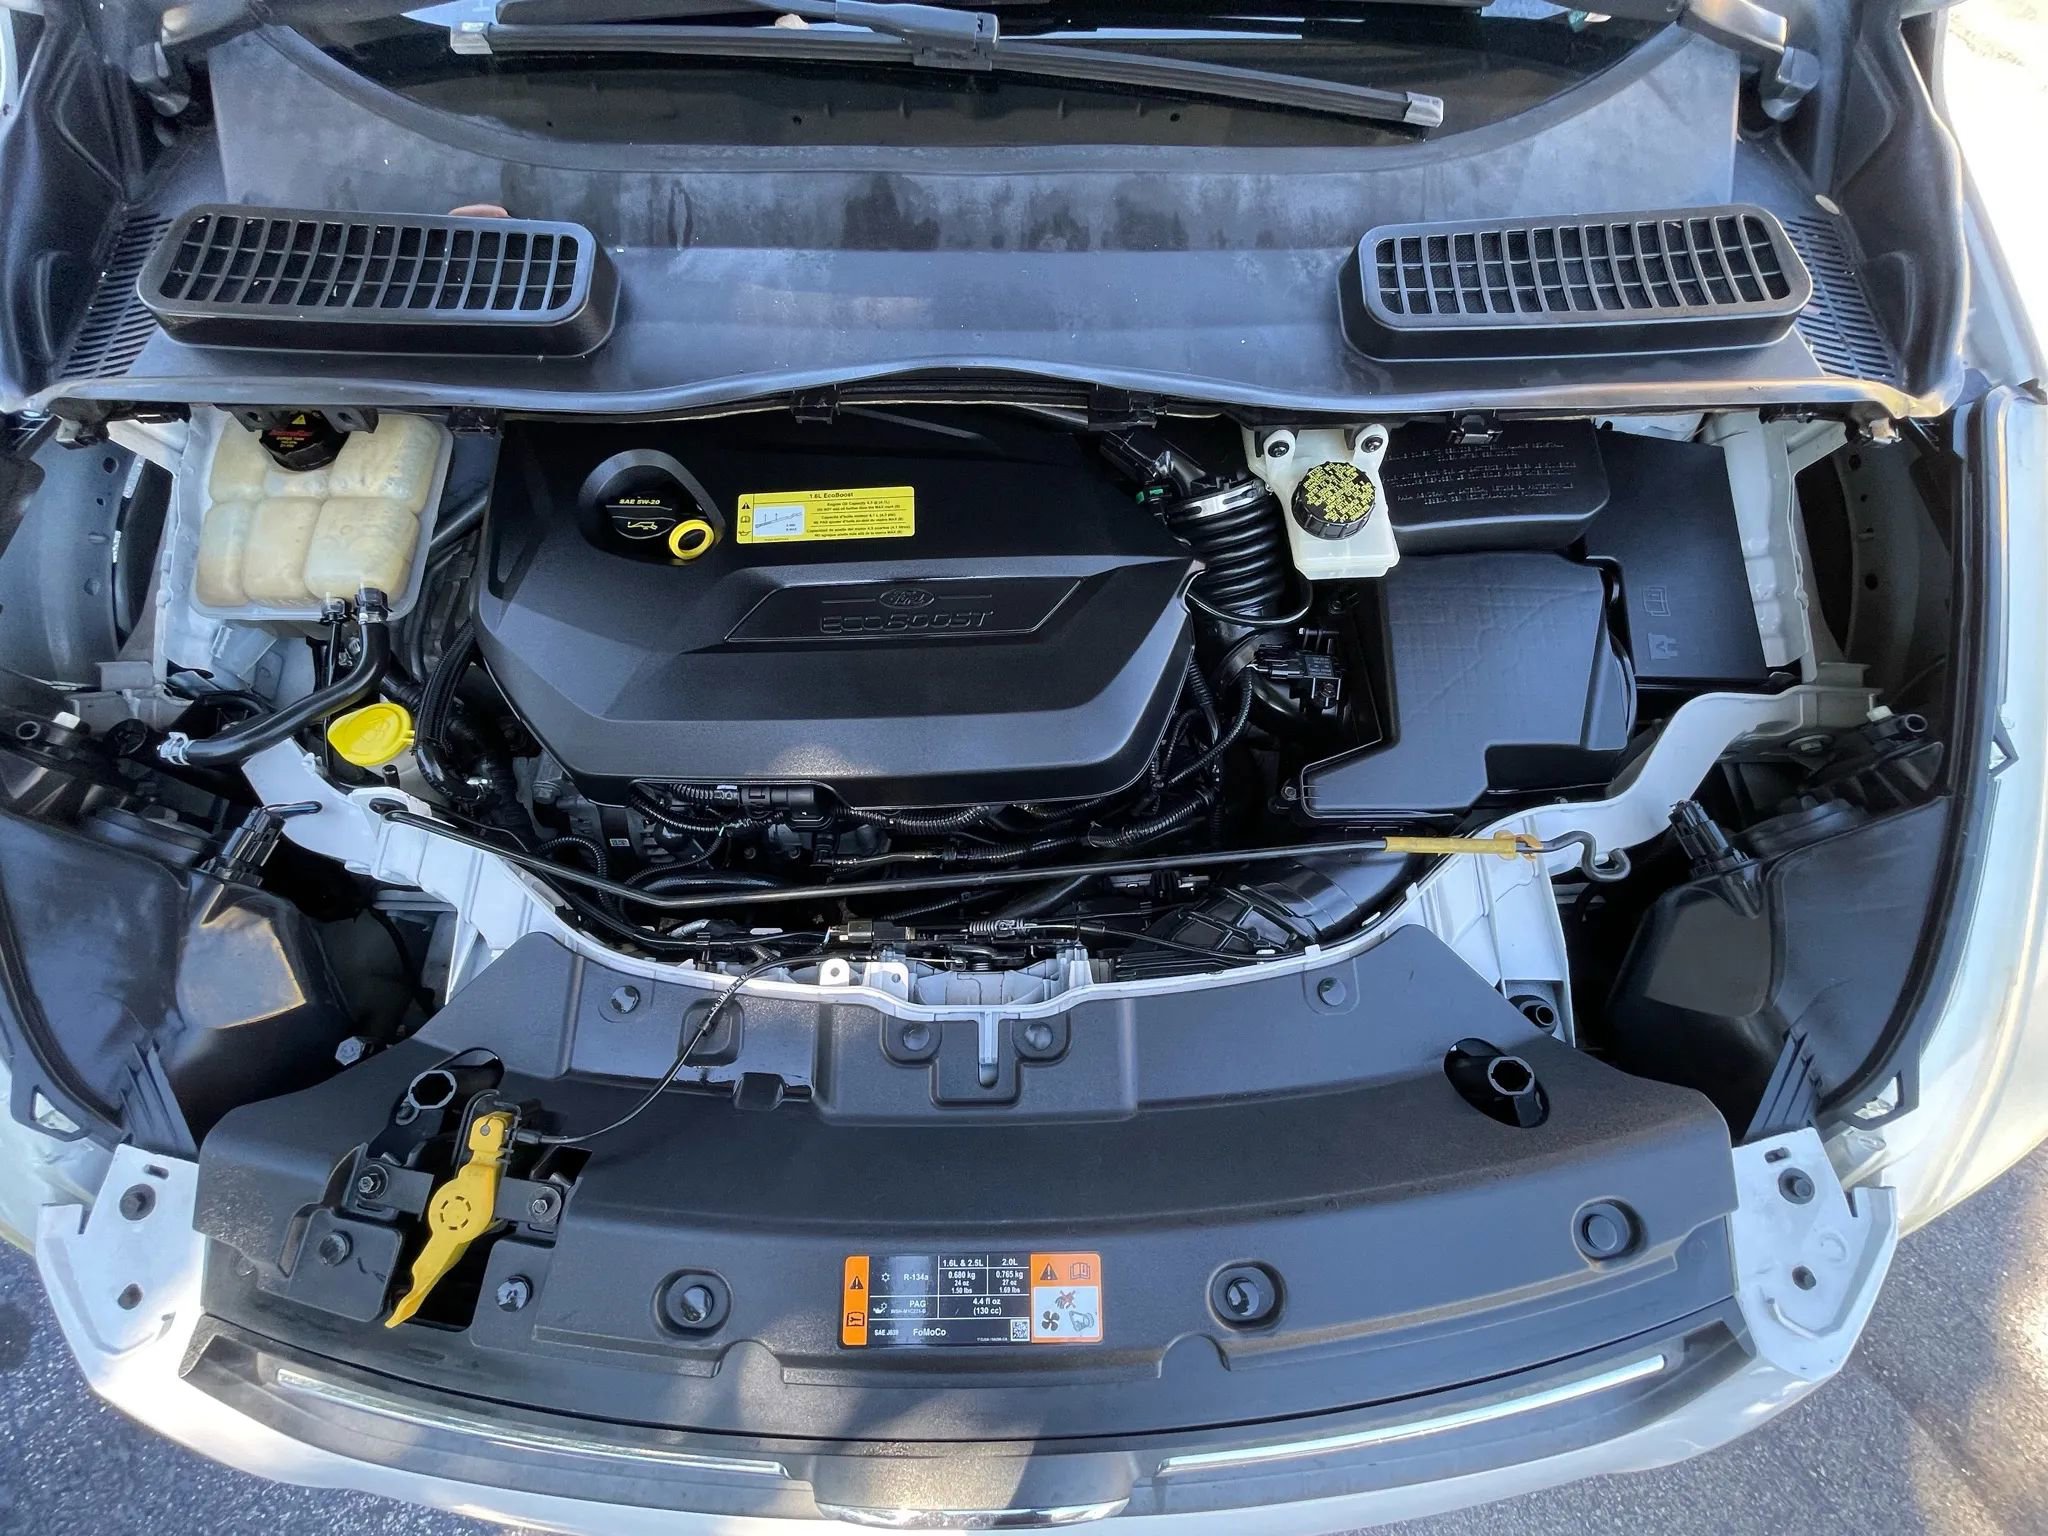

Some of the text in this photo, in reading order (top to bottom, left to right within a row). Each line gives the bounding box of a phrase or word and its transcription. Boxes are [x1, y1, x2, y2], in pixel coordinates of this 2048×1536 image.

[967, 1271, 976, 1280] kg
[1015, 1270, 1023, 1280] kg
[973, 1307, 1002, 1316] (130 cc)
[913, 1328, 946, 1337] FoMoCo
